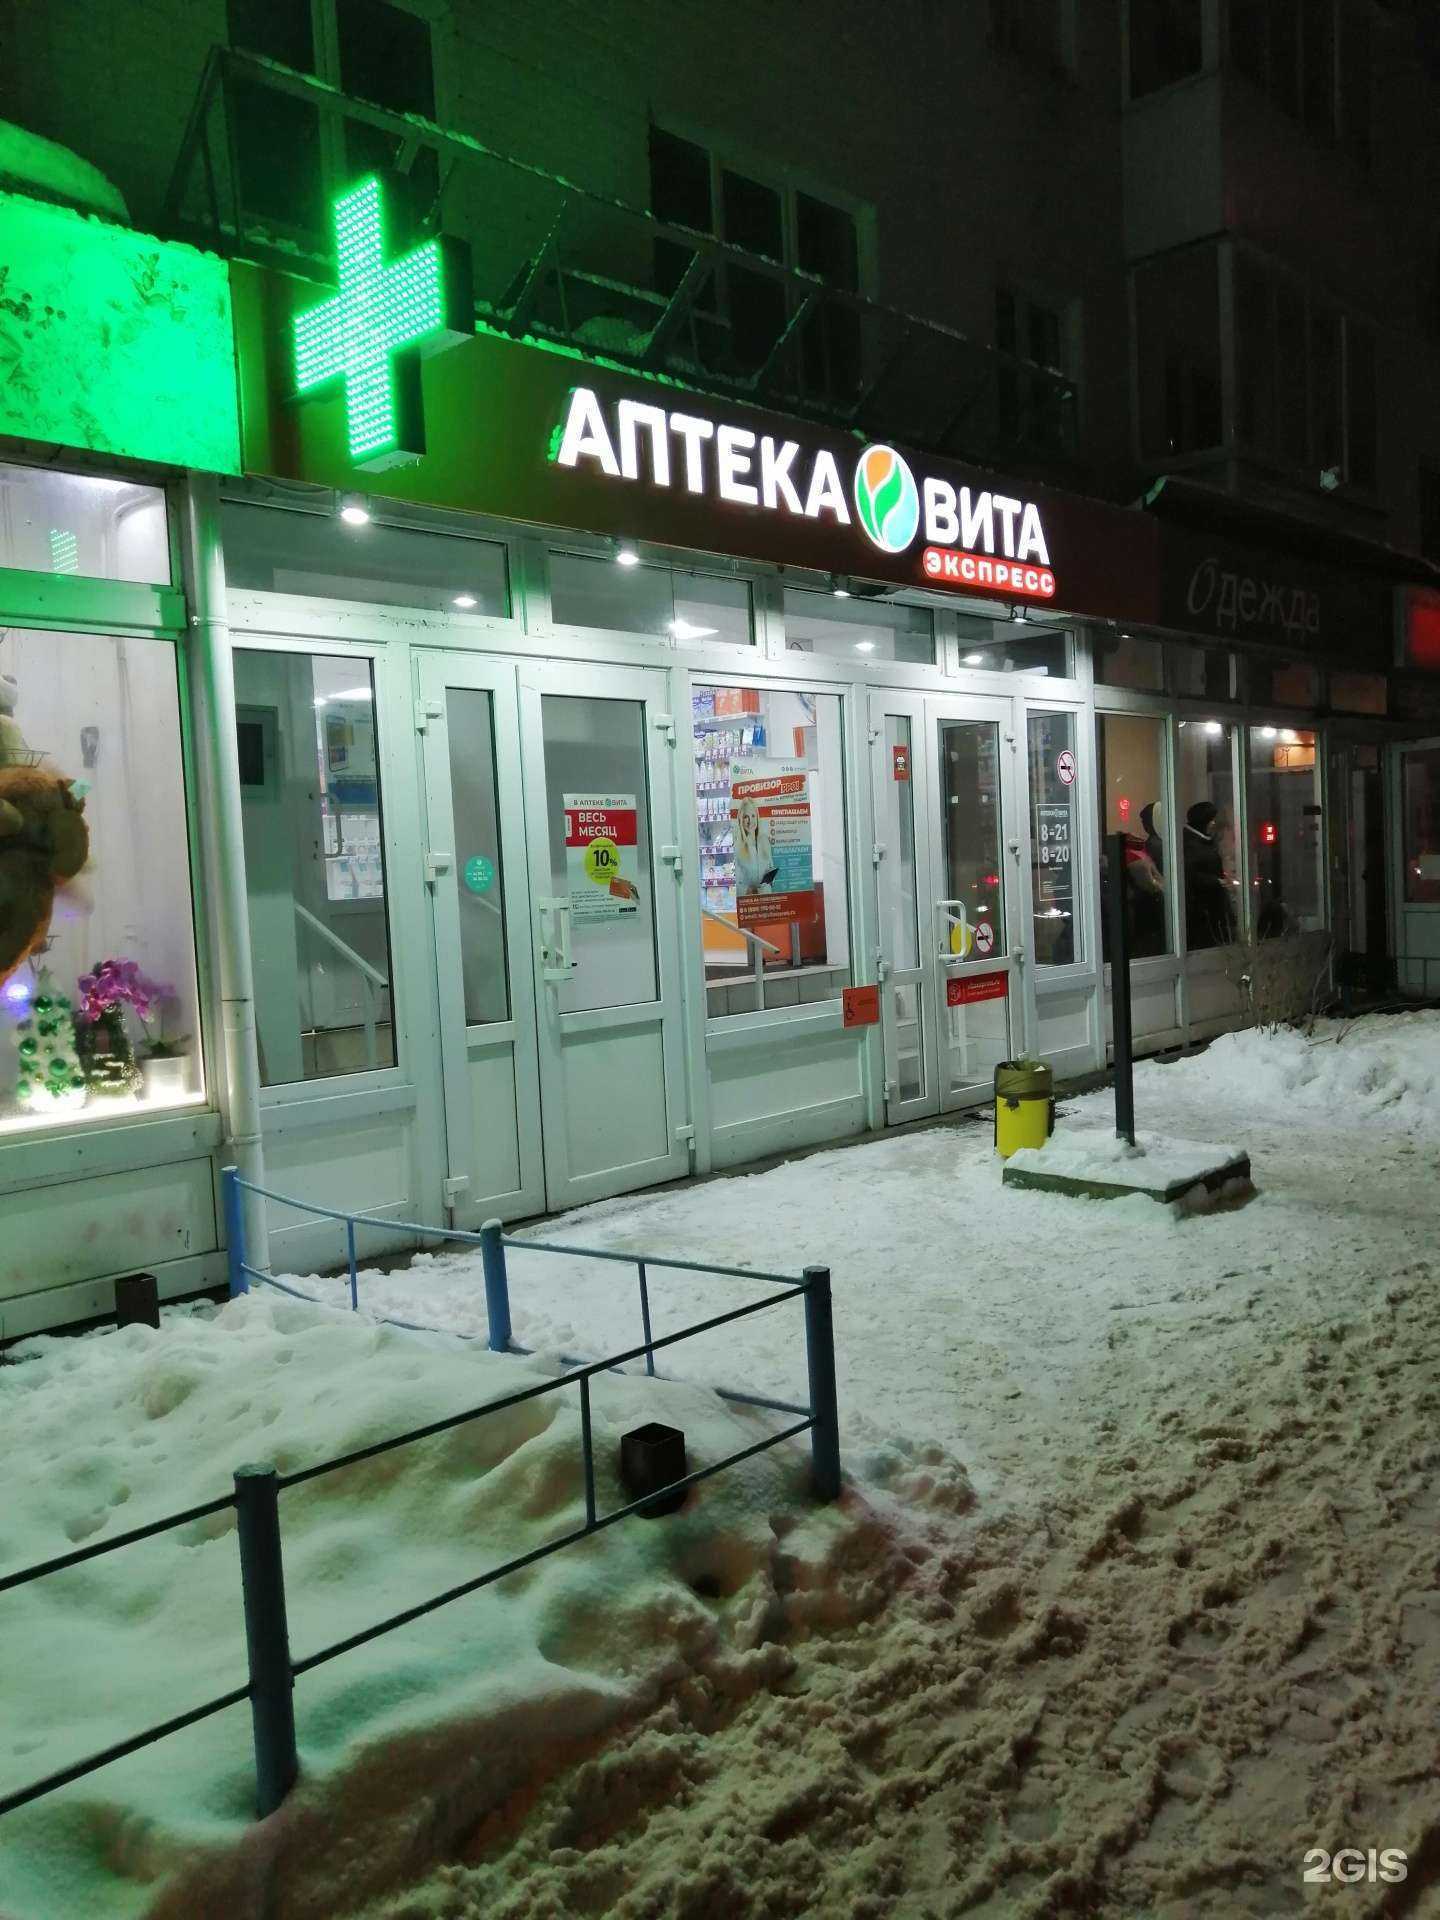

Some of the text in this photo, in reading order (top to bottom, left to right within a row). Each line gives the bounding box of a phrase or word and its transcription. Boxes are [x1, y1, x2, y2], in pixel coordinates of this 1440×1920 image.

[557, 387, 1052, 566] АПТЕКА ВИТА
[924, 550, 1055, 594] ЭКСПРЕСС
[1186, 557, 1321, 641] Одежда
[578, 812, 607, 823] ВЕСЬ
[578, 826, 618, 838] МЕСЯЦ
